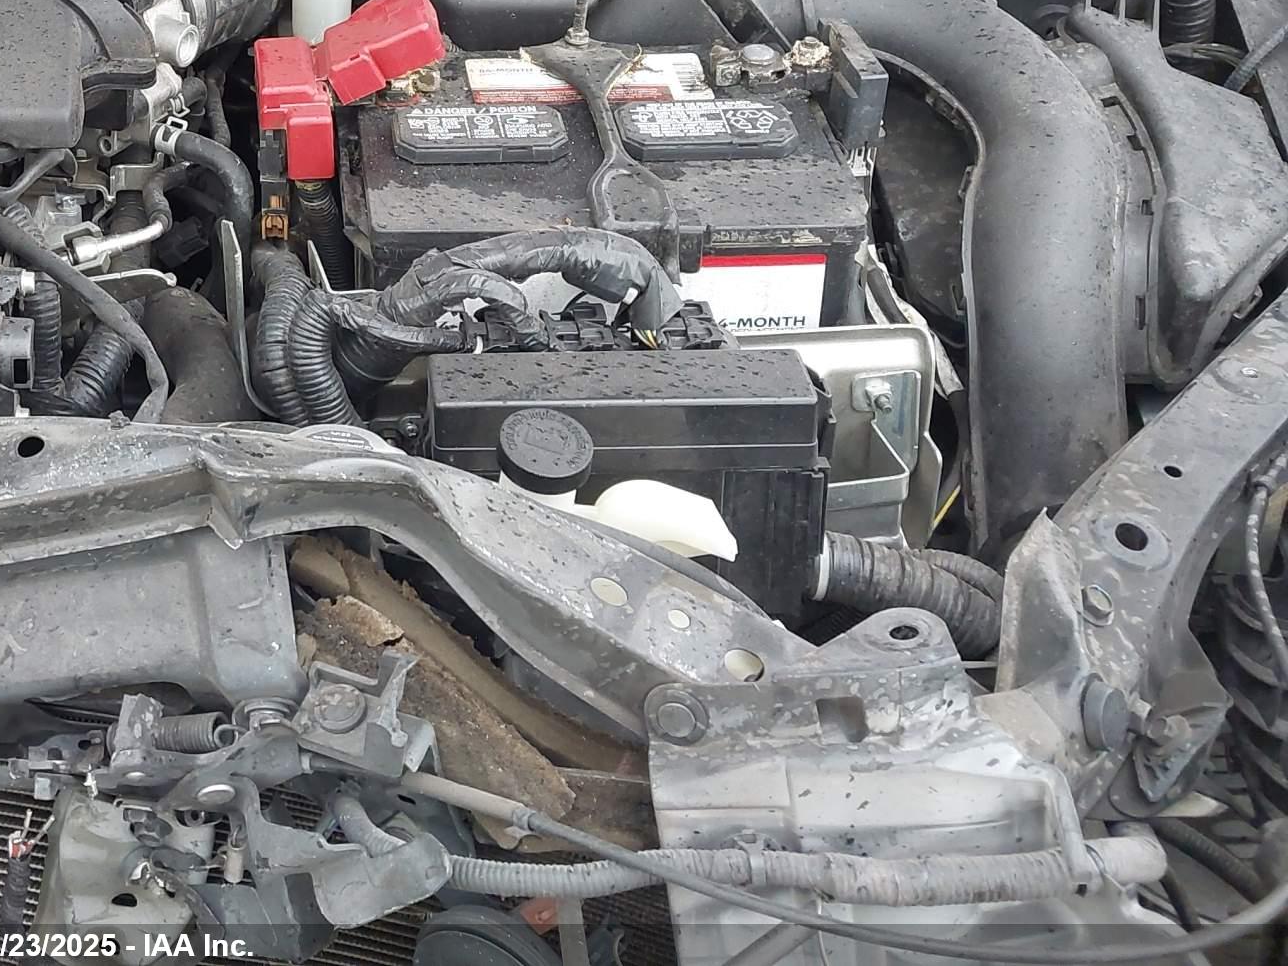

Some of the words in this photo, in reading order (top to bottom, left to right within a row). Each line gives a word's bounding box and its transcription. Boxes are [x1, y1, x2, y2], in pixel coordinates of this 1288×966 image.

[424, 107, 476, 115] DANGER
[489, 105, 537, 114] POISON
[717, 315, 806, 329] 4-MONTH
